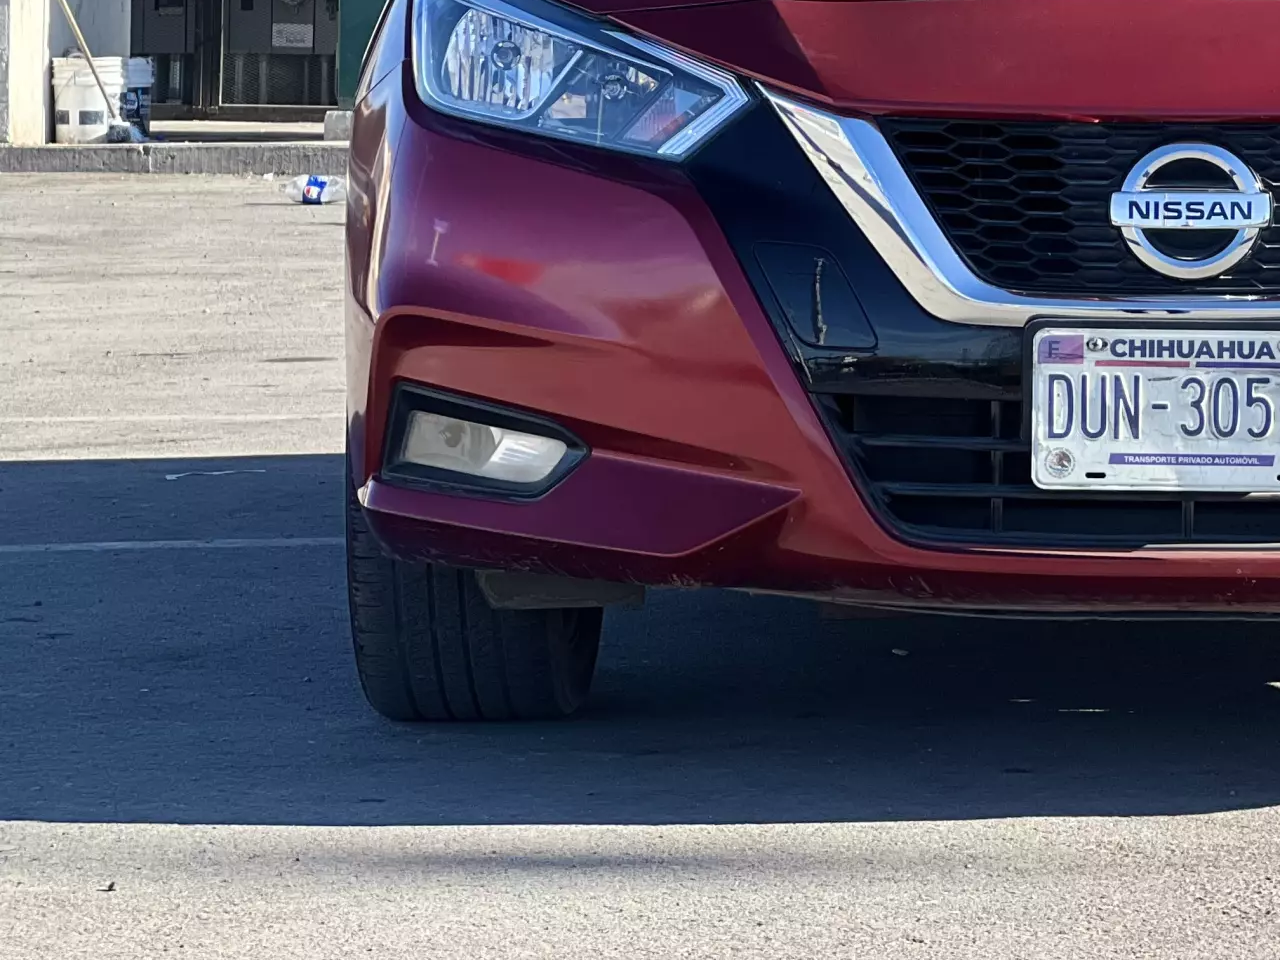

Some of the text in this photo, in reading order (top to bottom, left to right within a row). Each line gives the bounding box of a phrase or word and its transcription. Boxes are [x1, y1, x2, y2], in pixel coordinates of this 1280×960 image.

[1128, 200, 1252, 220] NISSAN
[1110, 338, 1276, 360] CHIHUAHUA
[1124, 455, 1260, 465] TRANSPORTE PRIVADO AUTOMÓVIL
